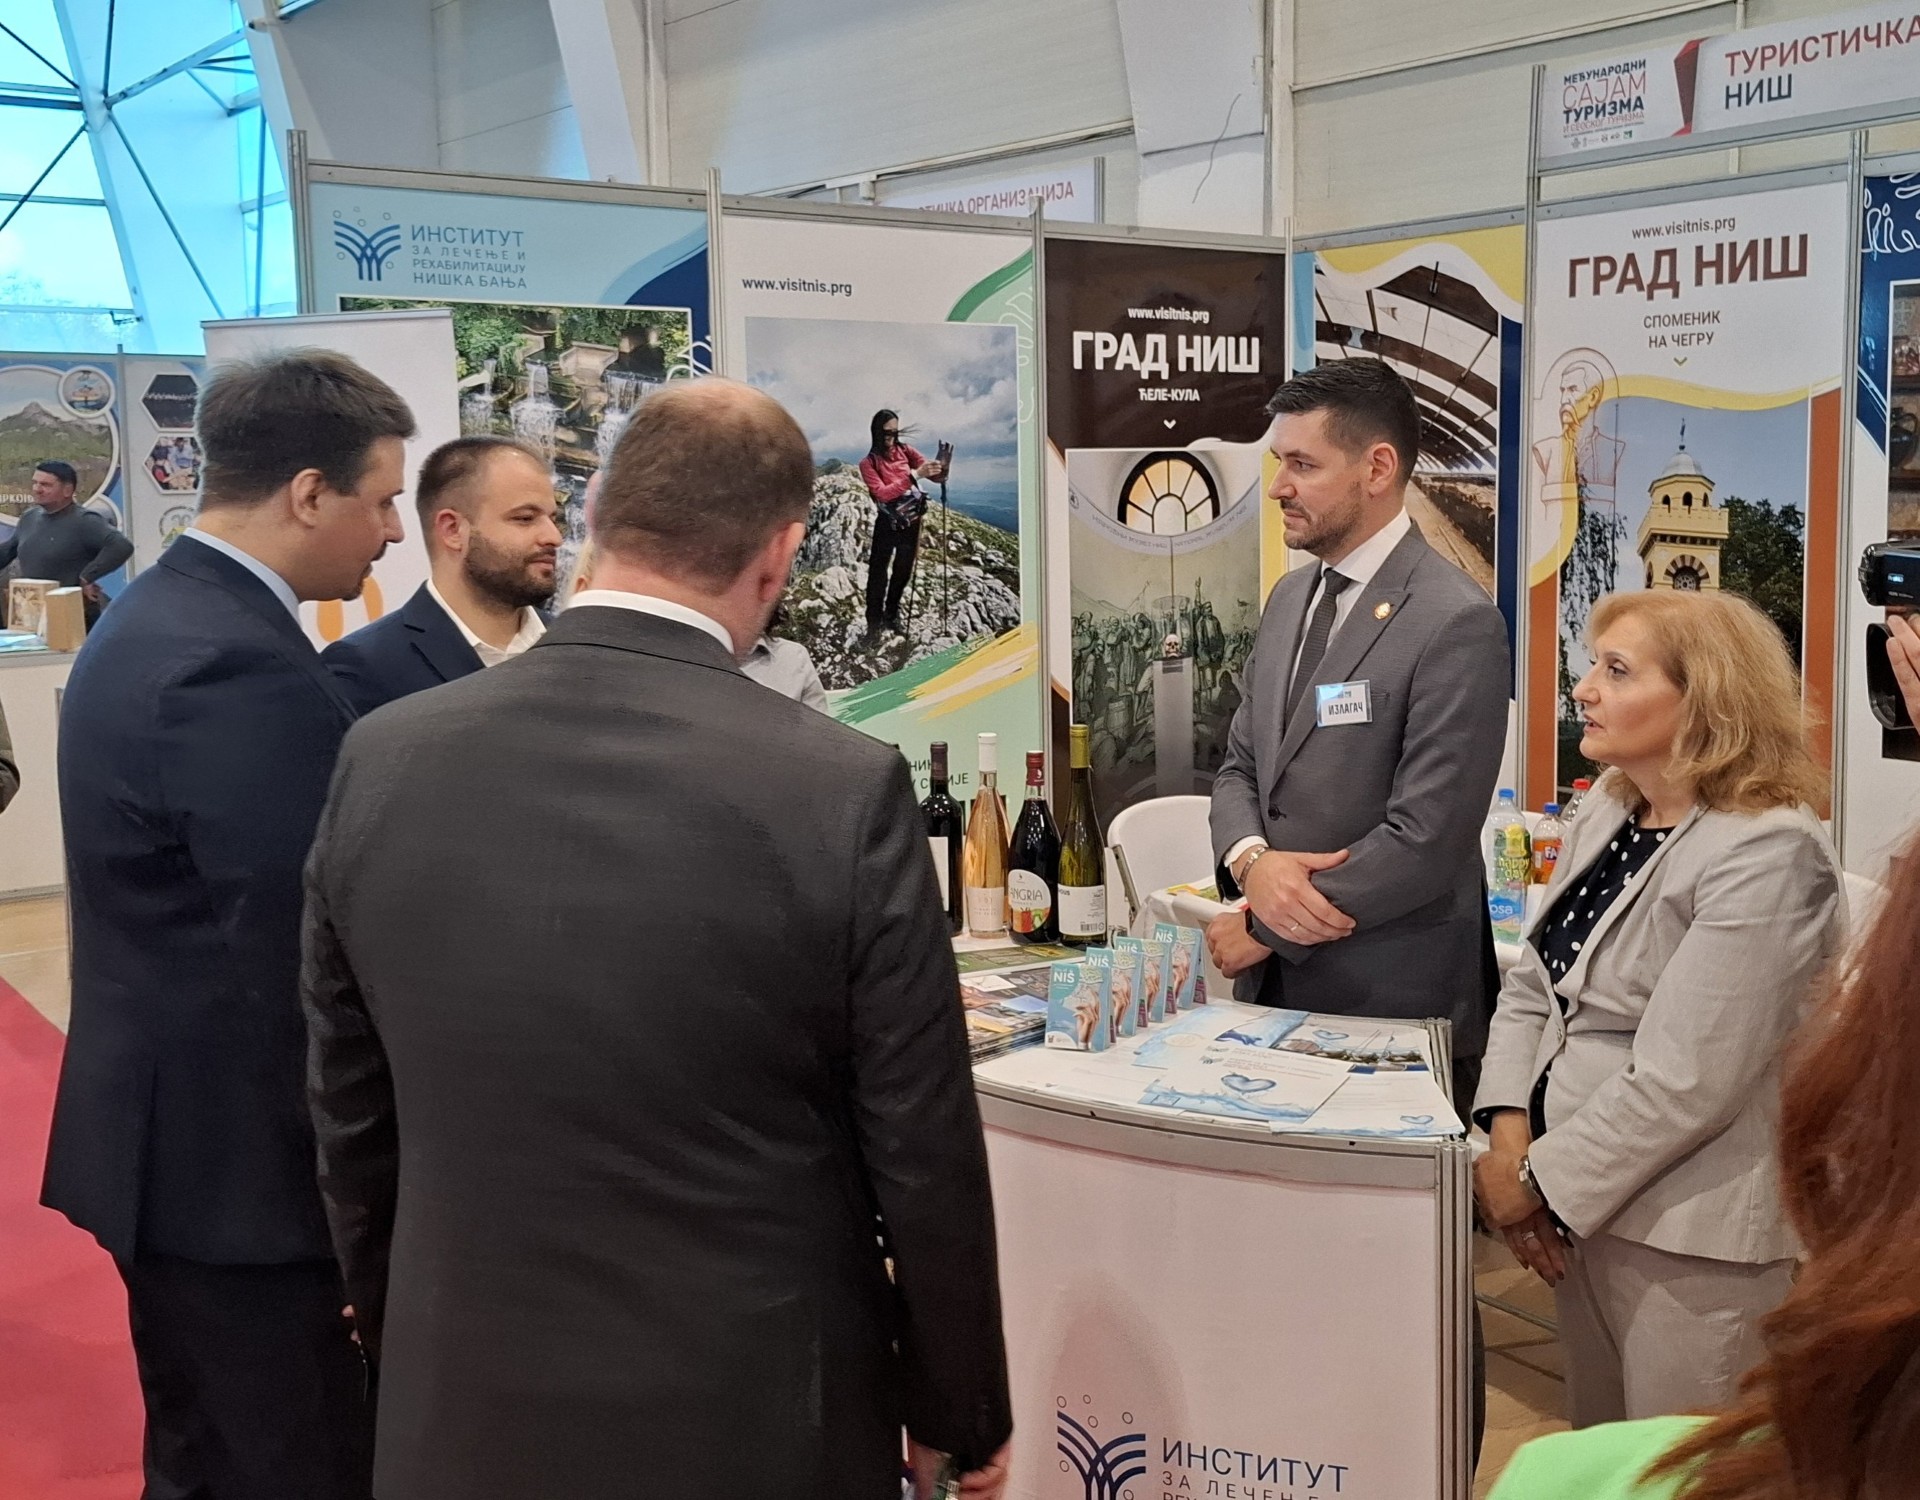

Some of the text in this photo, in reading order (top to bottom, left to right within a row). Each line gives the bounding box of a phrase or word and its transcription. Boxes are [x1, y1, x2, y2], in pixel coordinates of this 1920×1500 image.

[1725, 15, 1920, 77] ТУРИСТИЧКА
[1563, 59, 1646, 85] МЕЂУНАРОДНИ
[1562, 70, 1646, 110] САЈАМ
[1725, 73, 1792, 110] НИШ
[1563, 95, 1644, 124] ТУРИЗМА
[411, 224, 524, 247] ИНСТИТУТ
[1631, 217, 1736, 240] www.visitnis.prg
[412, 245, 526, 261] ЗА ЛЕЧЕЊЕ И
[412, 258, 526, 274] РЕХАБИЛИТАЦИЈУ
[1568, 233, 1809, 302] ГРАД НИШ
[413, 272, 527, 289] НИШКА БАЊА
[741, 278, 852, 297] www.visitnis.prg
[1127, 306, 1210, 324] www.visitnis.prg
[1643, 310, 1721, 329] СПОМЕНИК
[1648, 331, 1715, 349] НА ЧЕГРУ
[1072, 330, 1260, 380] ГРАД НИШ
[1138, 387, 1200, 401] ЋЕЛЕ-КУЛА
[1328, 702, 1364, 716] ИЗЛАГАЧ
[920, 772, 969, 789] СИЈЕ
[1053, 969, 1075, 984] NIŠ
[1162, 1436, 1349, 1493] ИНСТИТУТ
[1162, 1470, 1191, 1490] ЗА
[1206, 1479, 1319, 1500] ЛЕЧЕ
